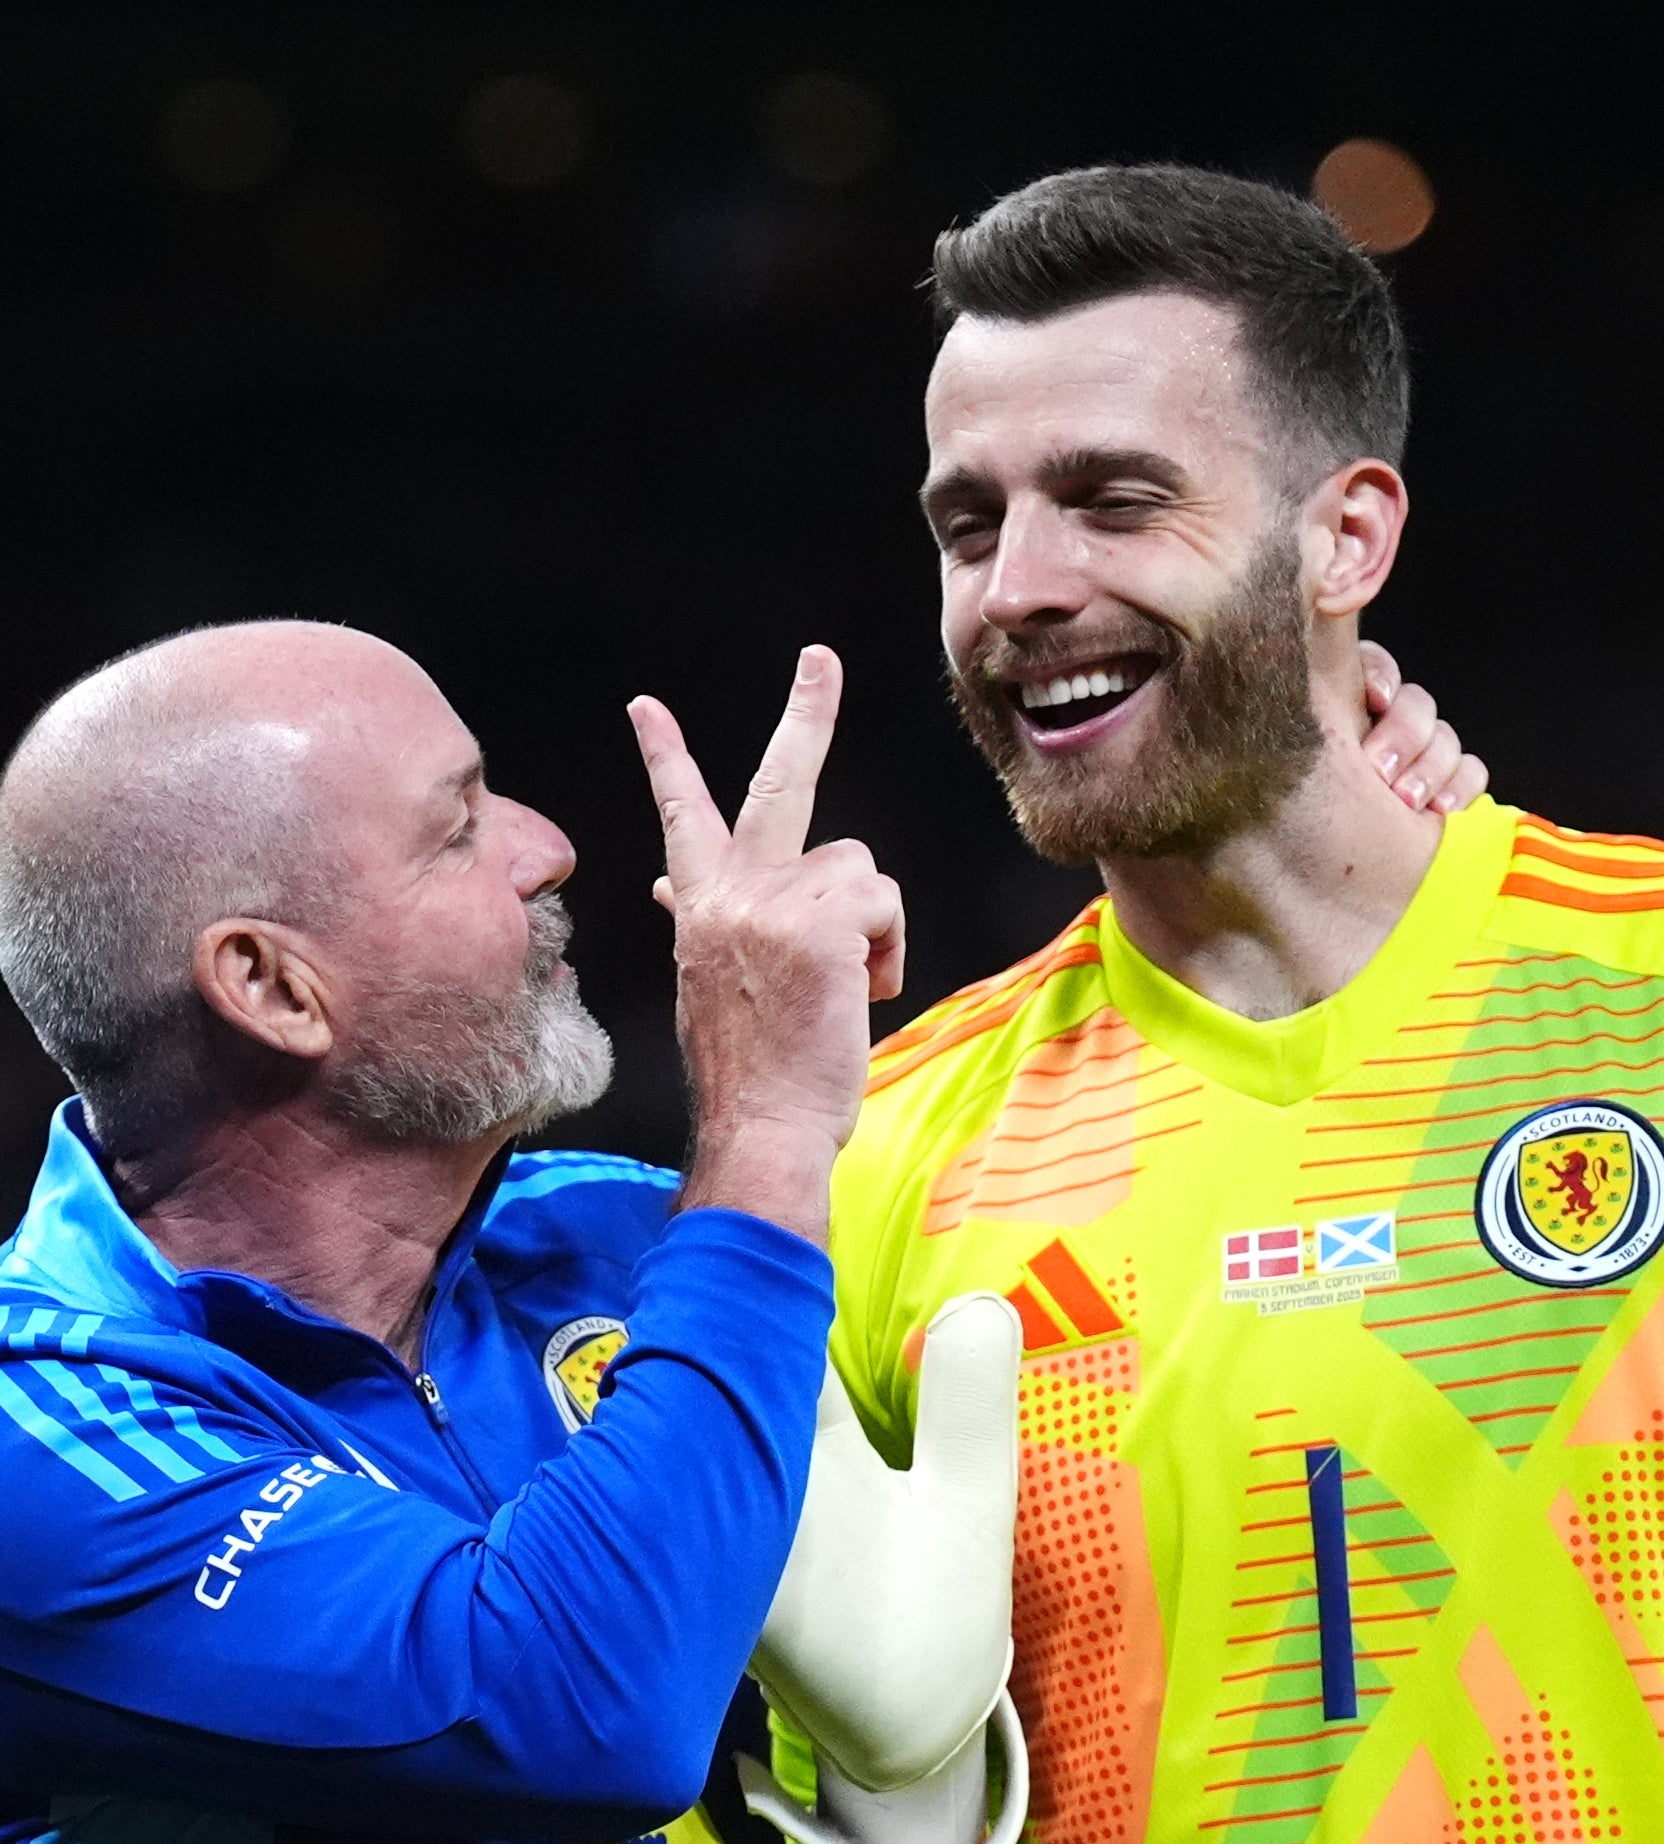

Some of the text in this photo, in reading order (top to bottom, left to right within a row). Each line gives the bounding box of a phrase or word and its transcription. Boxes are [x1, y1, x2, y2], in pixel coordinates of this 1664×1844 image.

[1529, 1111, 1617, 1138] SCOTLAND
[1512, 1237, 1647, 1265] EST 1873
[1325, 1268, 1397, 1289] COPENHAGEN
[1270, 1295, 1335, 1312] SEPTEMBER
[549, 1318, 607, 1359] SCOTLAND
[194, 1462, 328, 1611] CHASE
[1305, 1445, 1358, 1721] 1
